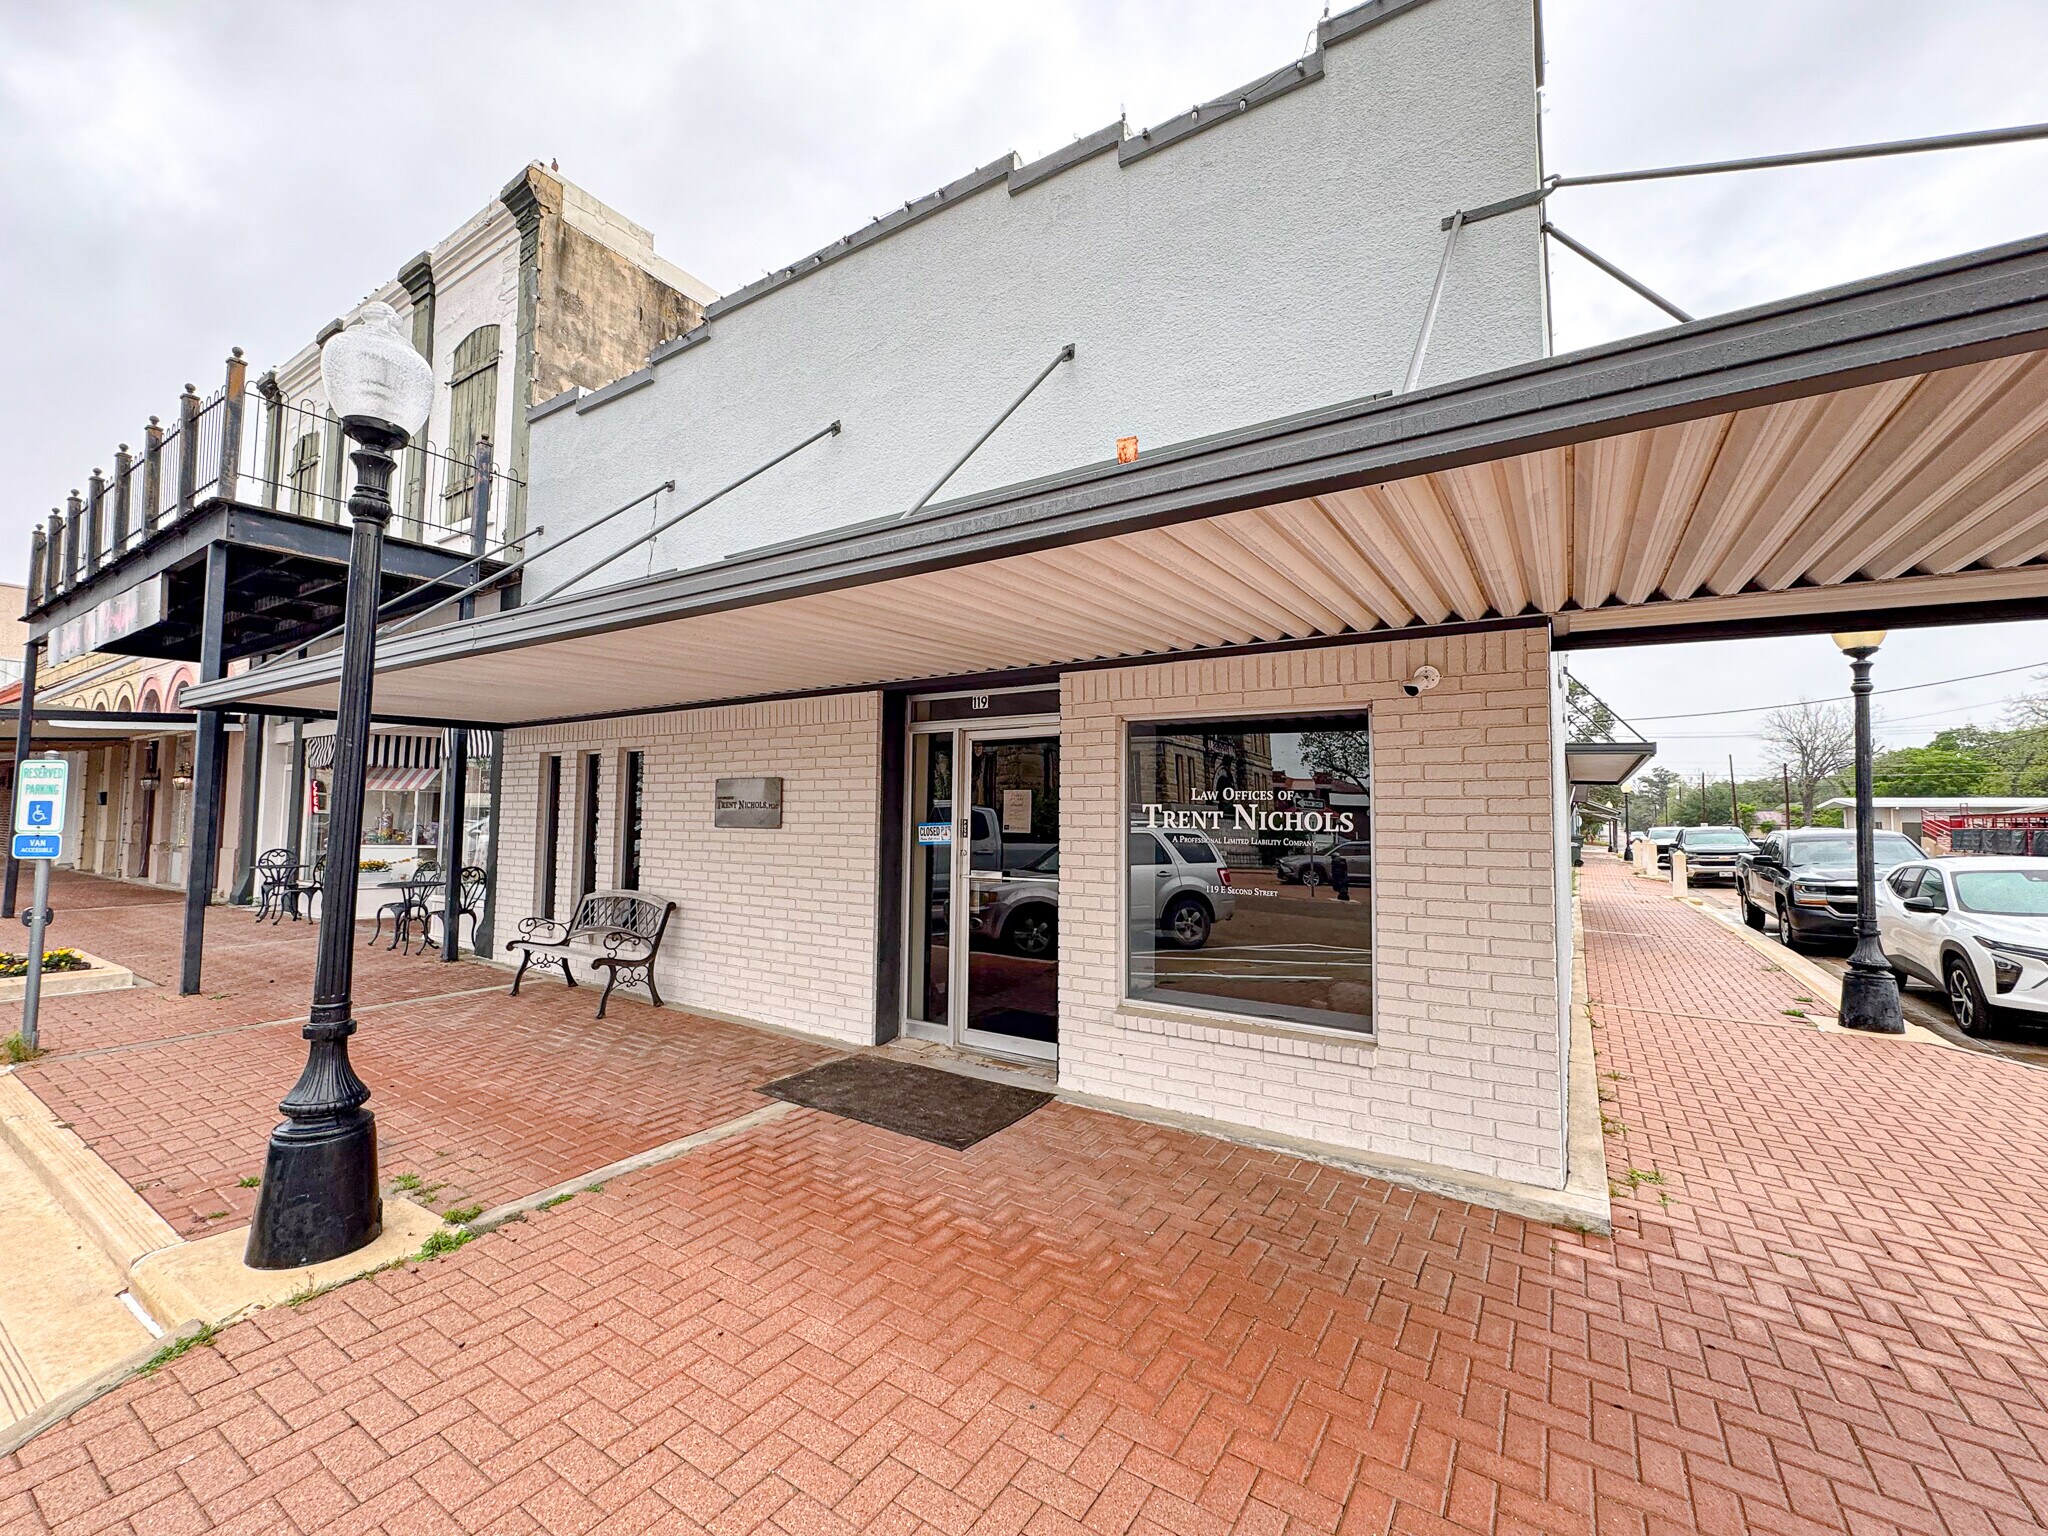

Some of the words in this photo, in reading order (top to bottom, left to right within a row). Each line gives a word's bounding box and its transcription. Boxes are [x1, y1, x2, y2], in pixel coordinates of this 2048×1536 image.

[973, 696, 988, 708] 119
[24, 767, 63, 779] RESERVED
[25, 784, 59, 795] PARKING
[1191, 788, 1217, 801] LAW
[1222, 787, 1274, 801] OFFICES
[1278, 790, 1295, 801] OF
[717, 800, 737, 810] TRENT
[1142, 803, 1224, 830] TRENT
[1233, 804, 1354, 833] NICHOLS
[920, 826, 940, 837] CLOSED
[29, 839, 47, 847] VAN
[1180, 836, 1222, 844] PROFESSIONAL
[1223, 837, 1249, 845] LIMITED
[1251, 837, 1282, 846] LIABILITY
[1283, 838, 1317, 847] COMPANY
[1220, 886, 1226, 894] E
[1227, 887, 1253, 896] SECOND
[1254, 888, 1279, 897] STREET
